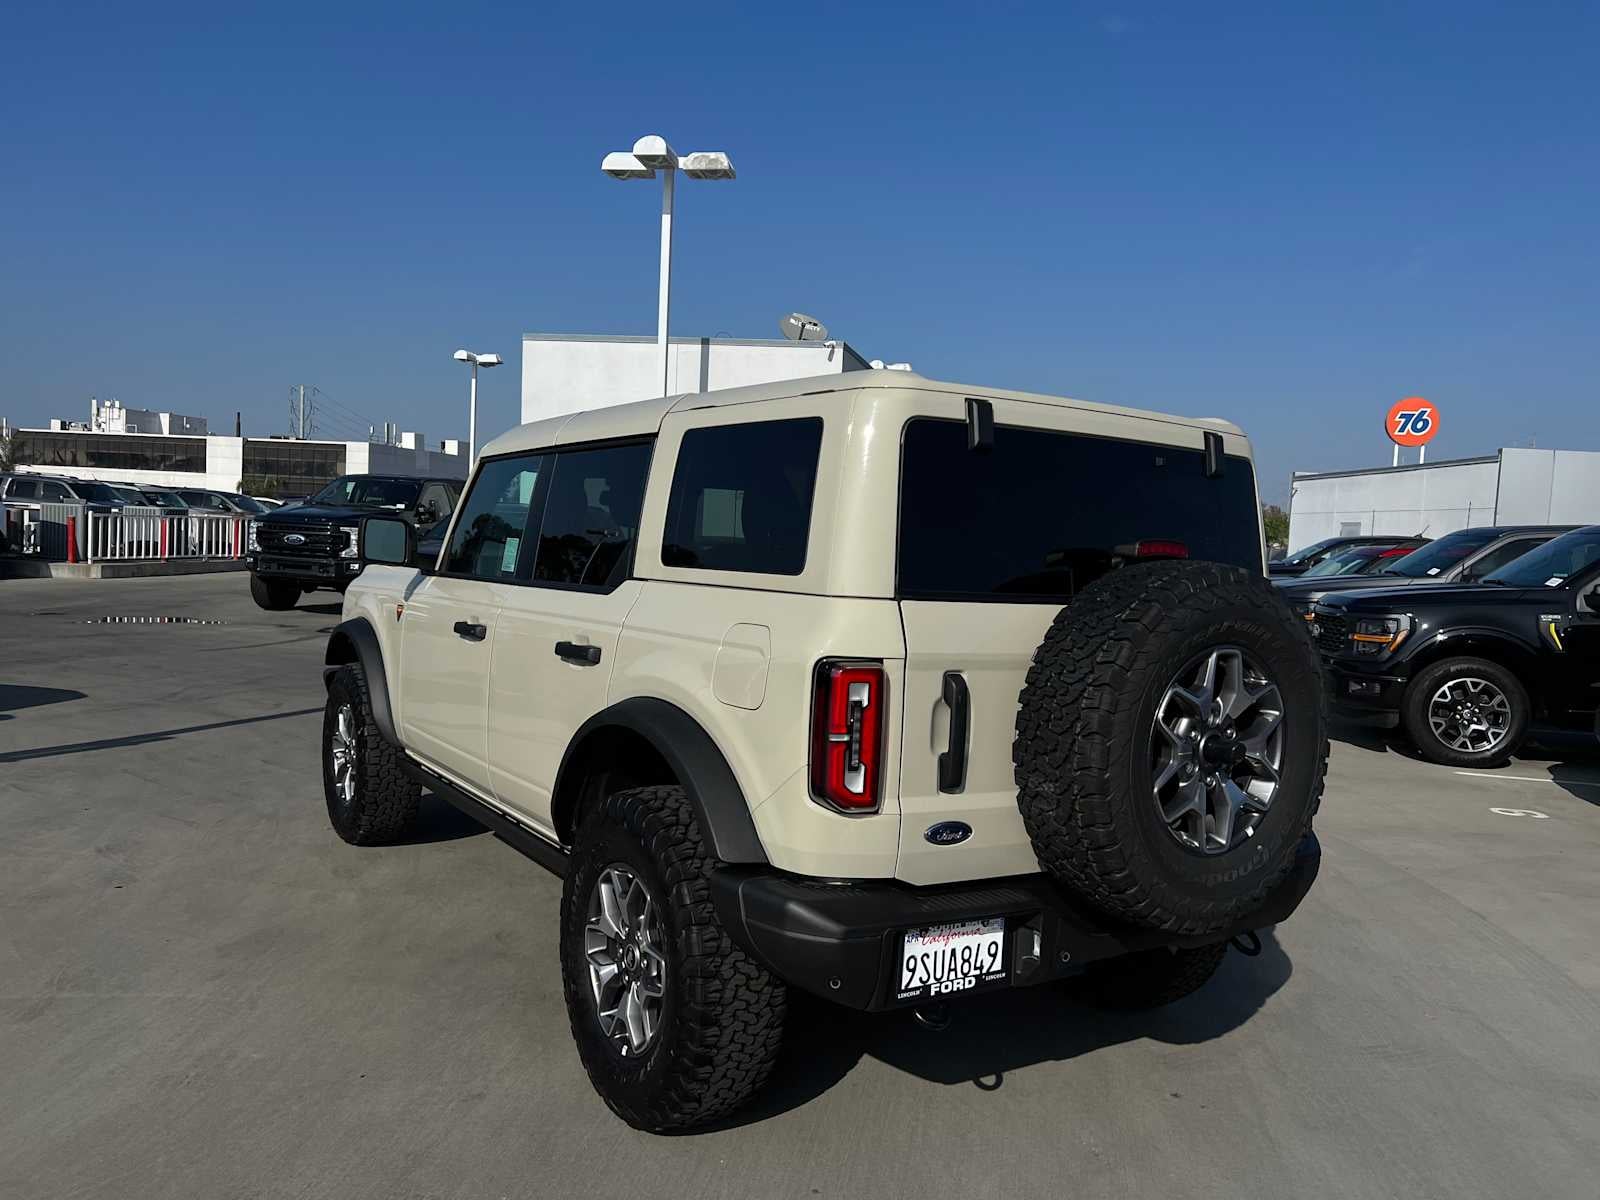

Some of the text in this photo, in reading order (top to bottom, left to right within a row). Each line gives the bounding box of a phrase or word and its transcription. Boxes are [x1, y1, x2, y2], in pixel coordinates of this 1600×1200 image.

[1394, 407, 1432, 436] 76
[921, 927, 983, 946] California
[904, 940, 999, 990] 9SUA849
[897, 972, 1006, 1000] LINCOLN FORD LINCOLN
